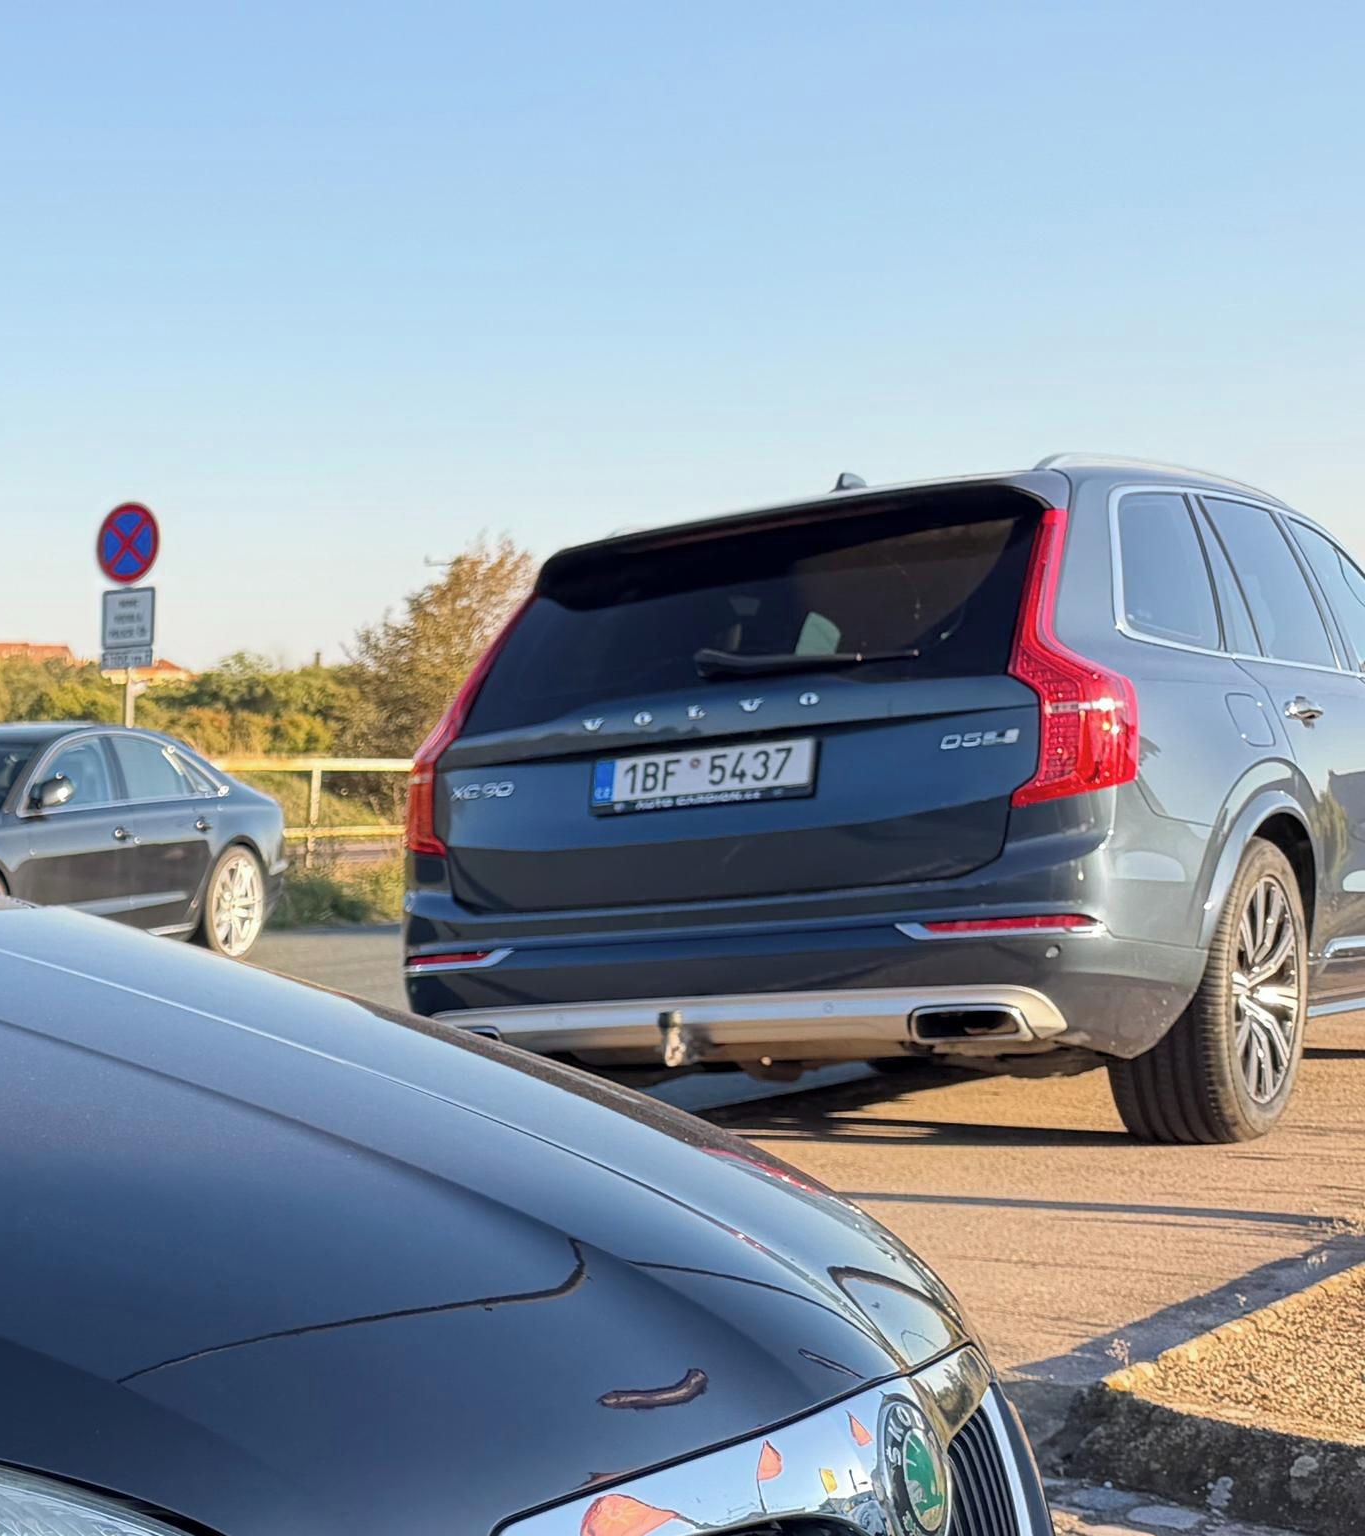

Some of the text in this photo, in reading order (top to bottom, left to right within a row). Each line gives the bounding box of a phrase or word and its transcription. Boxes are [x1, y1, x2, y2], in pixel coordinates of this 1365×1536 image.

[582, 691, 819, 731] VOLVO
[624, 747, 794, 795] 1BF 5437
